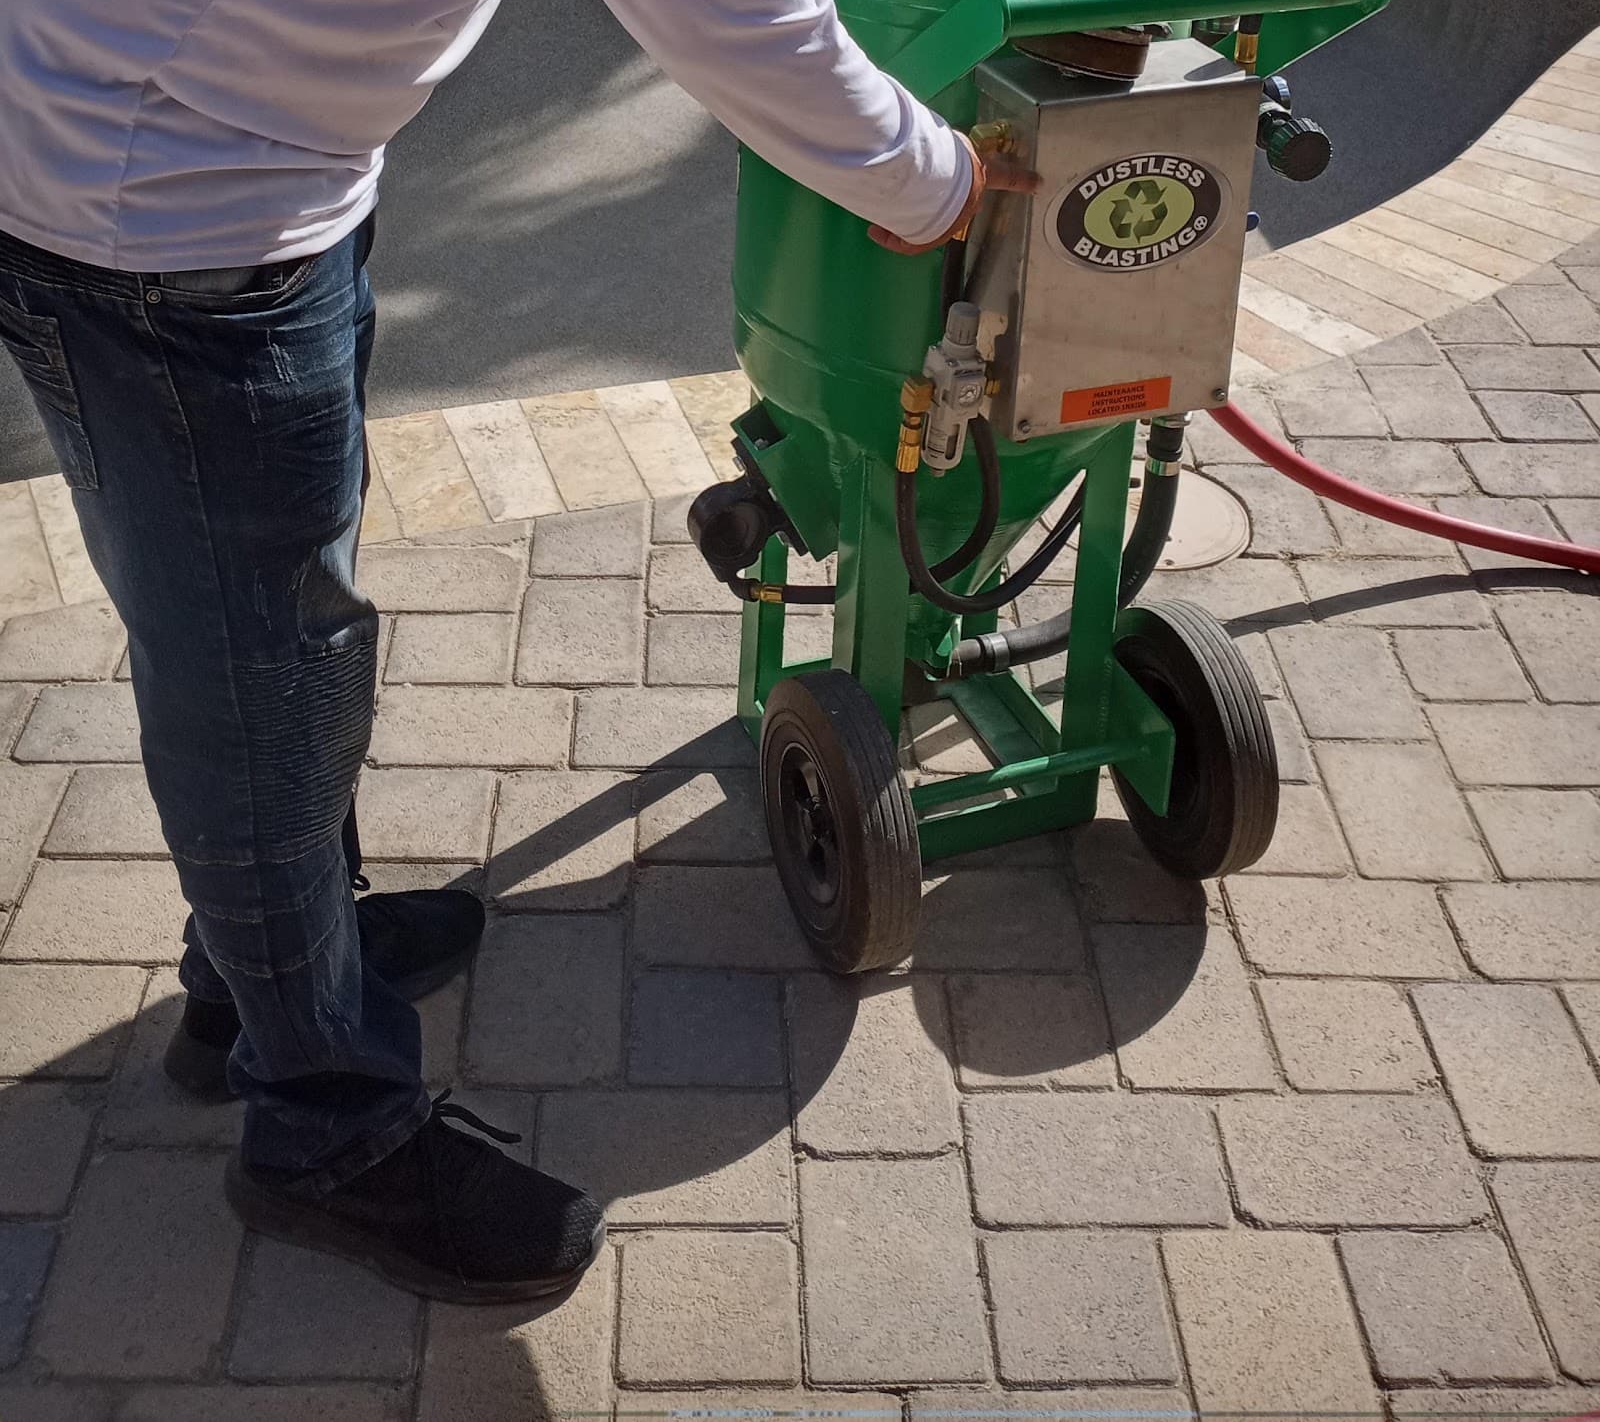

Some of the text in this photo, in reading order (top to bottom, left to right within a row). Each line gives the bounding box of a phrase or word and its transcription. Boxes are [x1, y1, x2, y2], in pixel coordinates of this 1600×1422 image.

[1078, 157, 1206, 200] DUSTLESS
[1094, 386, 1144, 397] MAINTENANCE
[1092, 393, 1144, 406] INSTRUCTIONS
[1088, 401, 1146, 416] LOCATED INSIDE
